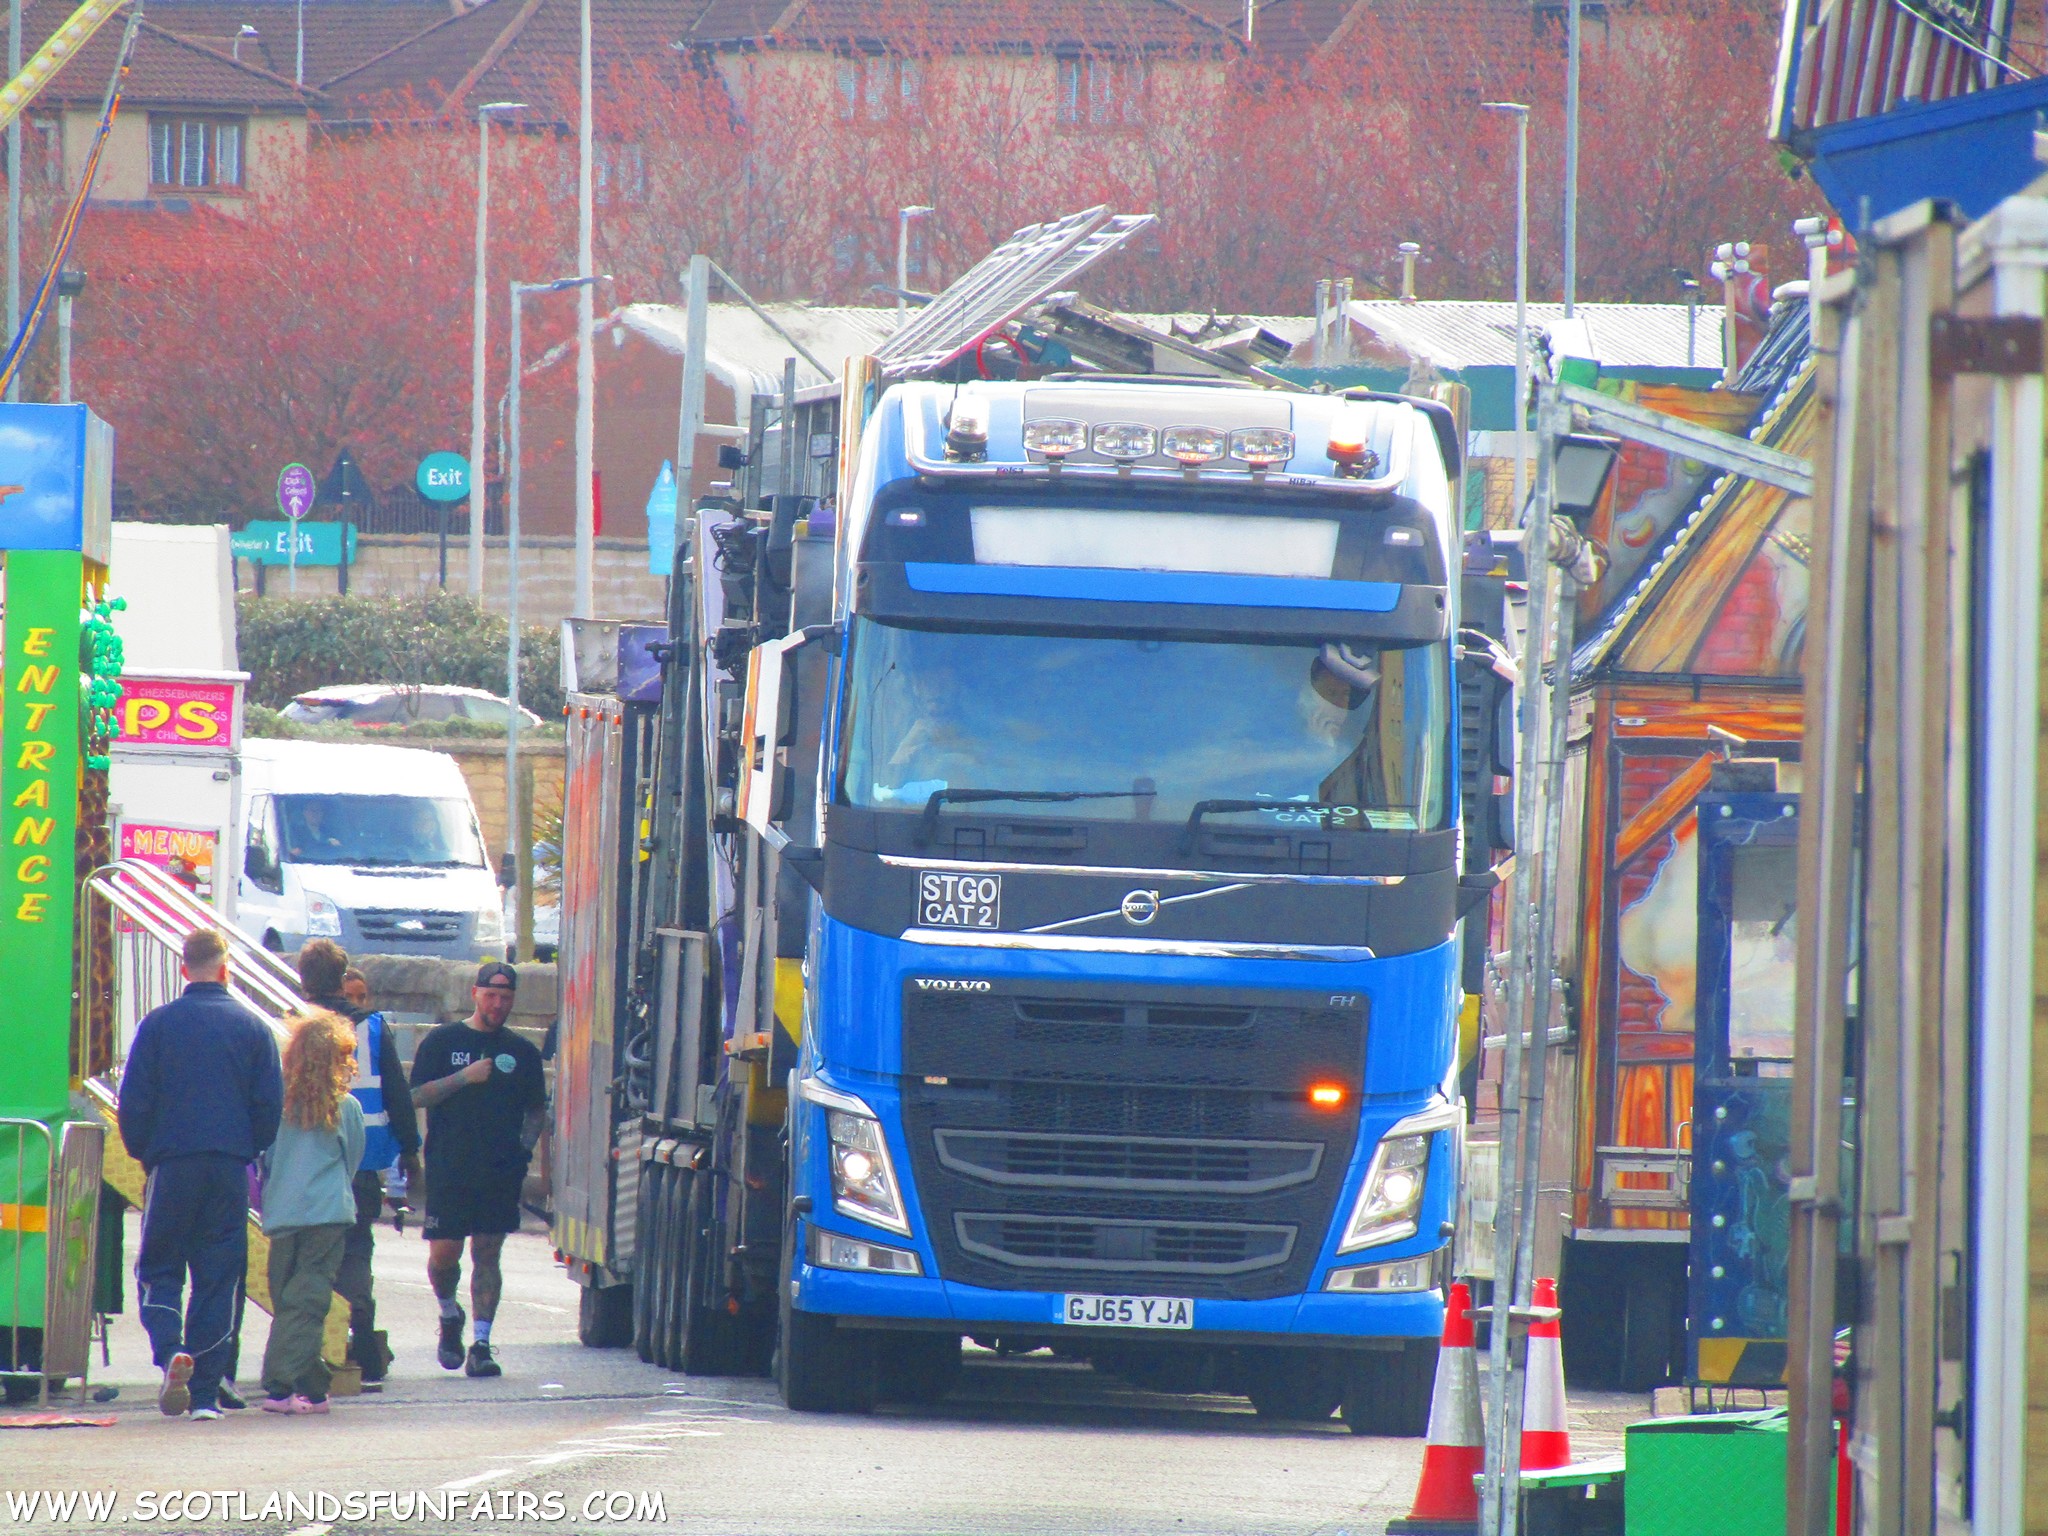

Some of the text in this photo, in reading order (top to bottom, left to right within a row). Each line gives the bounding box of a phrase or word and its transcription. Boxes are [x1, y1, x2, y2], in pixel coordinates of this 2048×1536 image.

[428, 468, 462, 485] Exit
[276, 531, 314, 554] Eit
[139, 688, 226, 701] CHEESEBURGERS
[13, 627, 60, 922] ENTRANCE
[1276, 813, 1346, 825] CAT 2
[133, 829, 203, 856] MENU
[923, 874, 997, 904] STGO
[925, 903, 993, 926] CAT 2
[915, 978, 991, 993] VOLVO
[1329, 995, 1356, 1007] FH
[1069, 1298, 1188, 1325] GJ65 YJA
